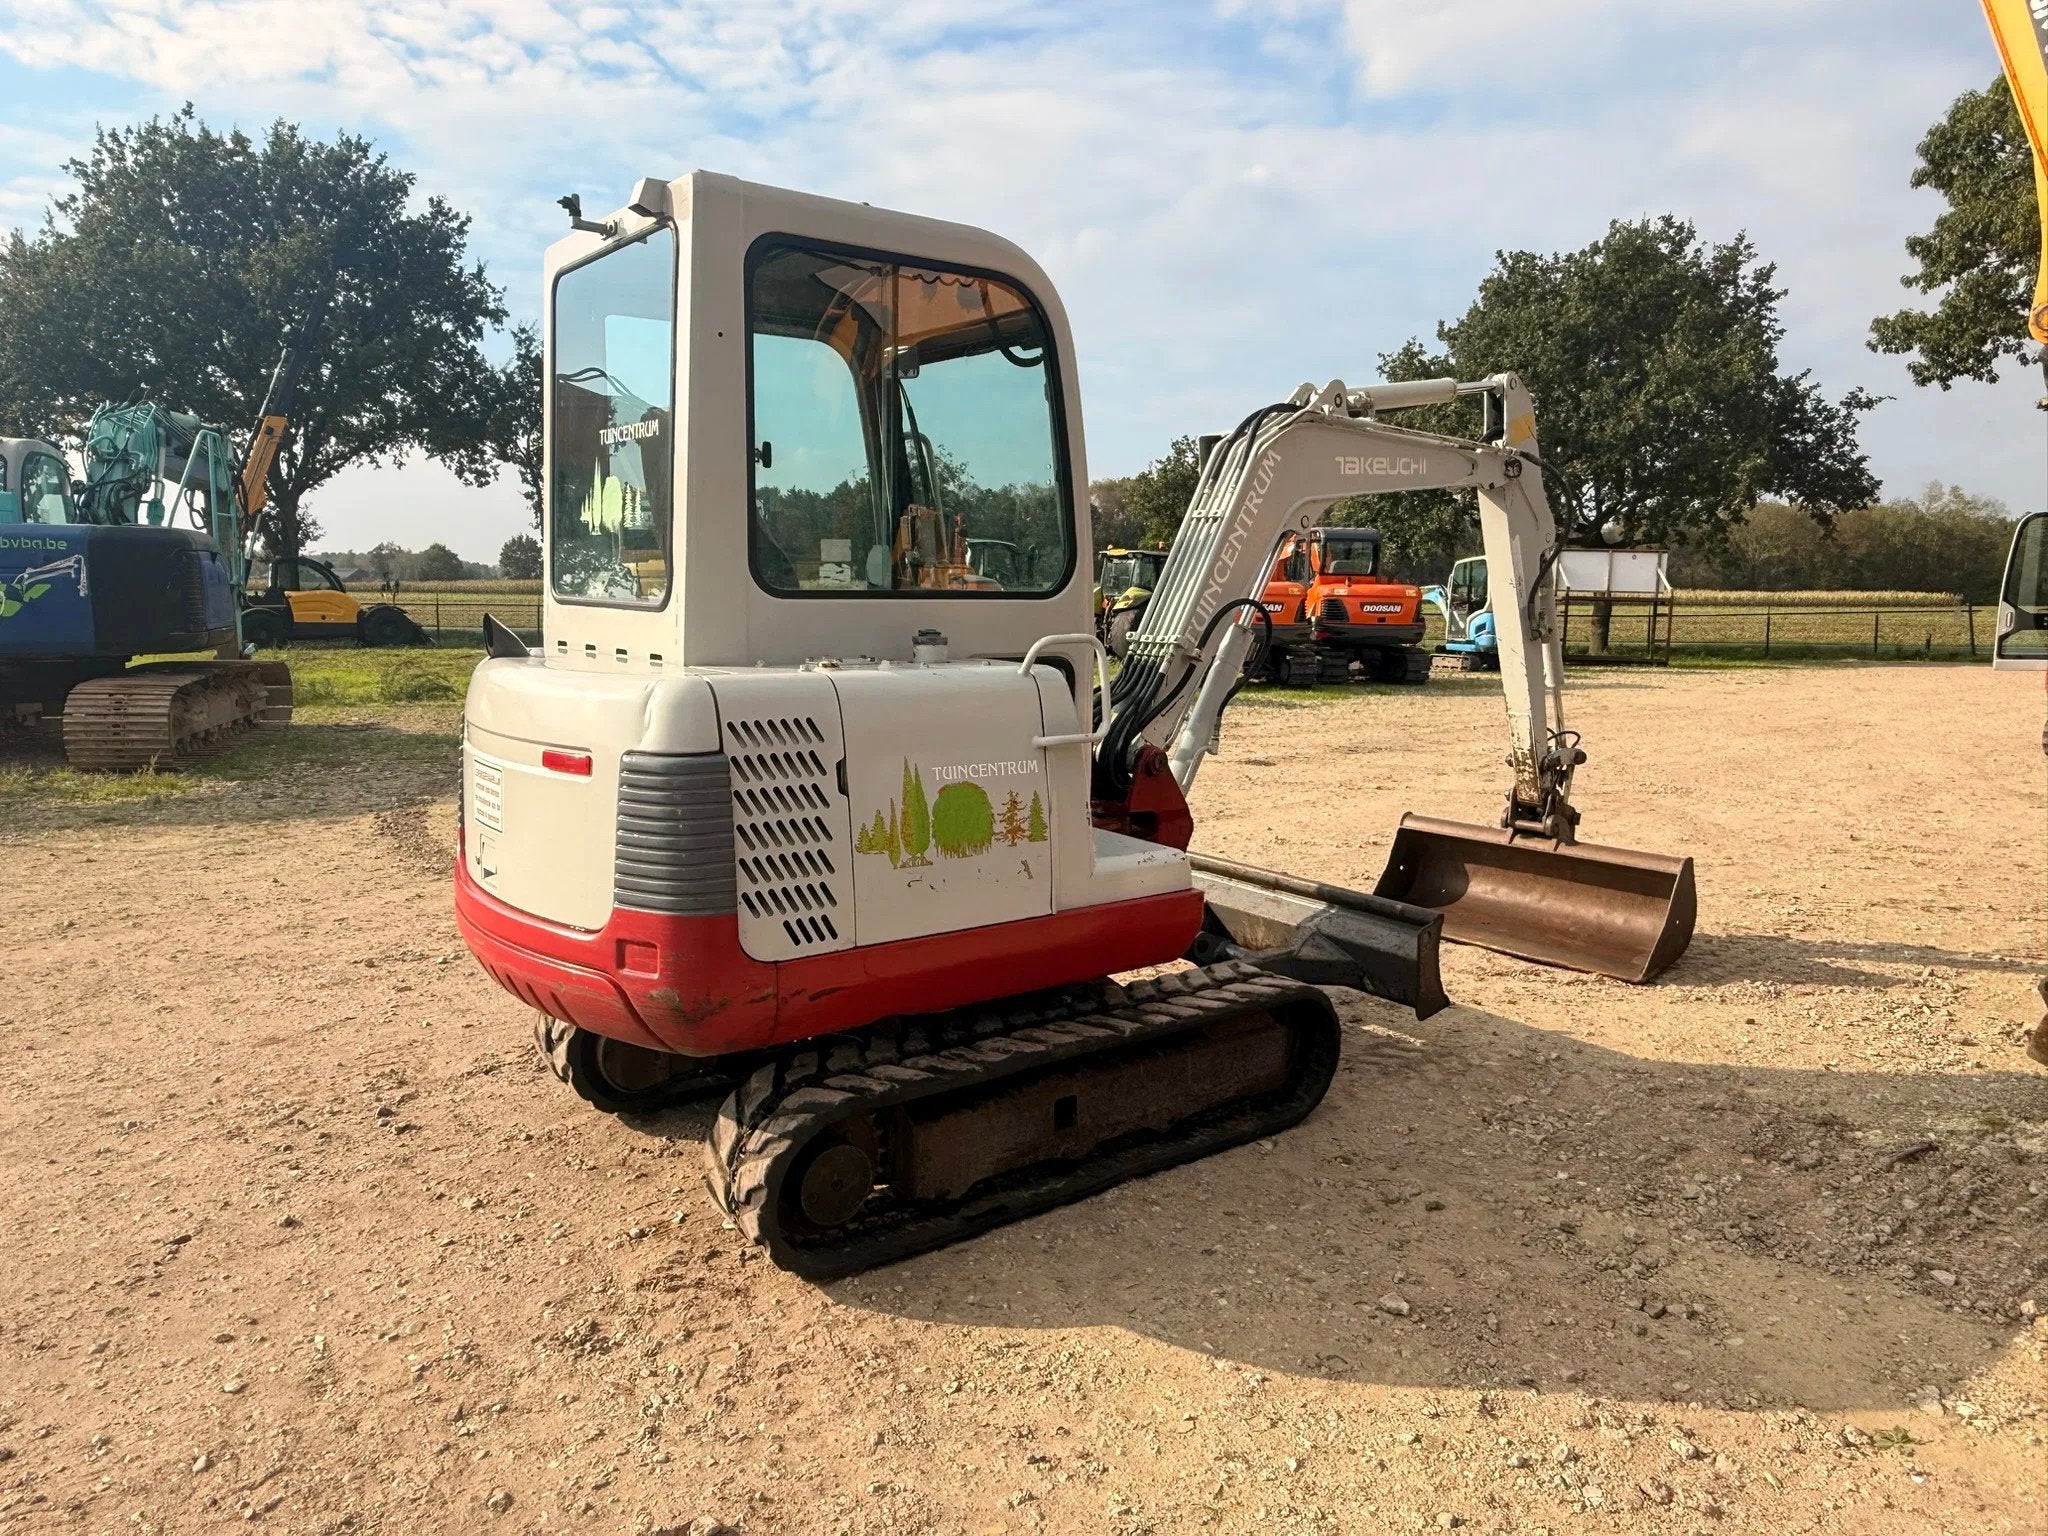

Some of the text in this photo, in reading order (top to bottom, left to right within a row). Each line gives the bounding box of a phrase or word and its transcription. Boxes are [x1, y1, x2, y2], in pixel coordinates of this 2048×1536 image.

[599, 419, 659, 446] TUINCENTRUM
[1363, 604, 1401, 612] DOOSAN
[932, 759, 1038, 781] TUINCENTRUM
